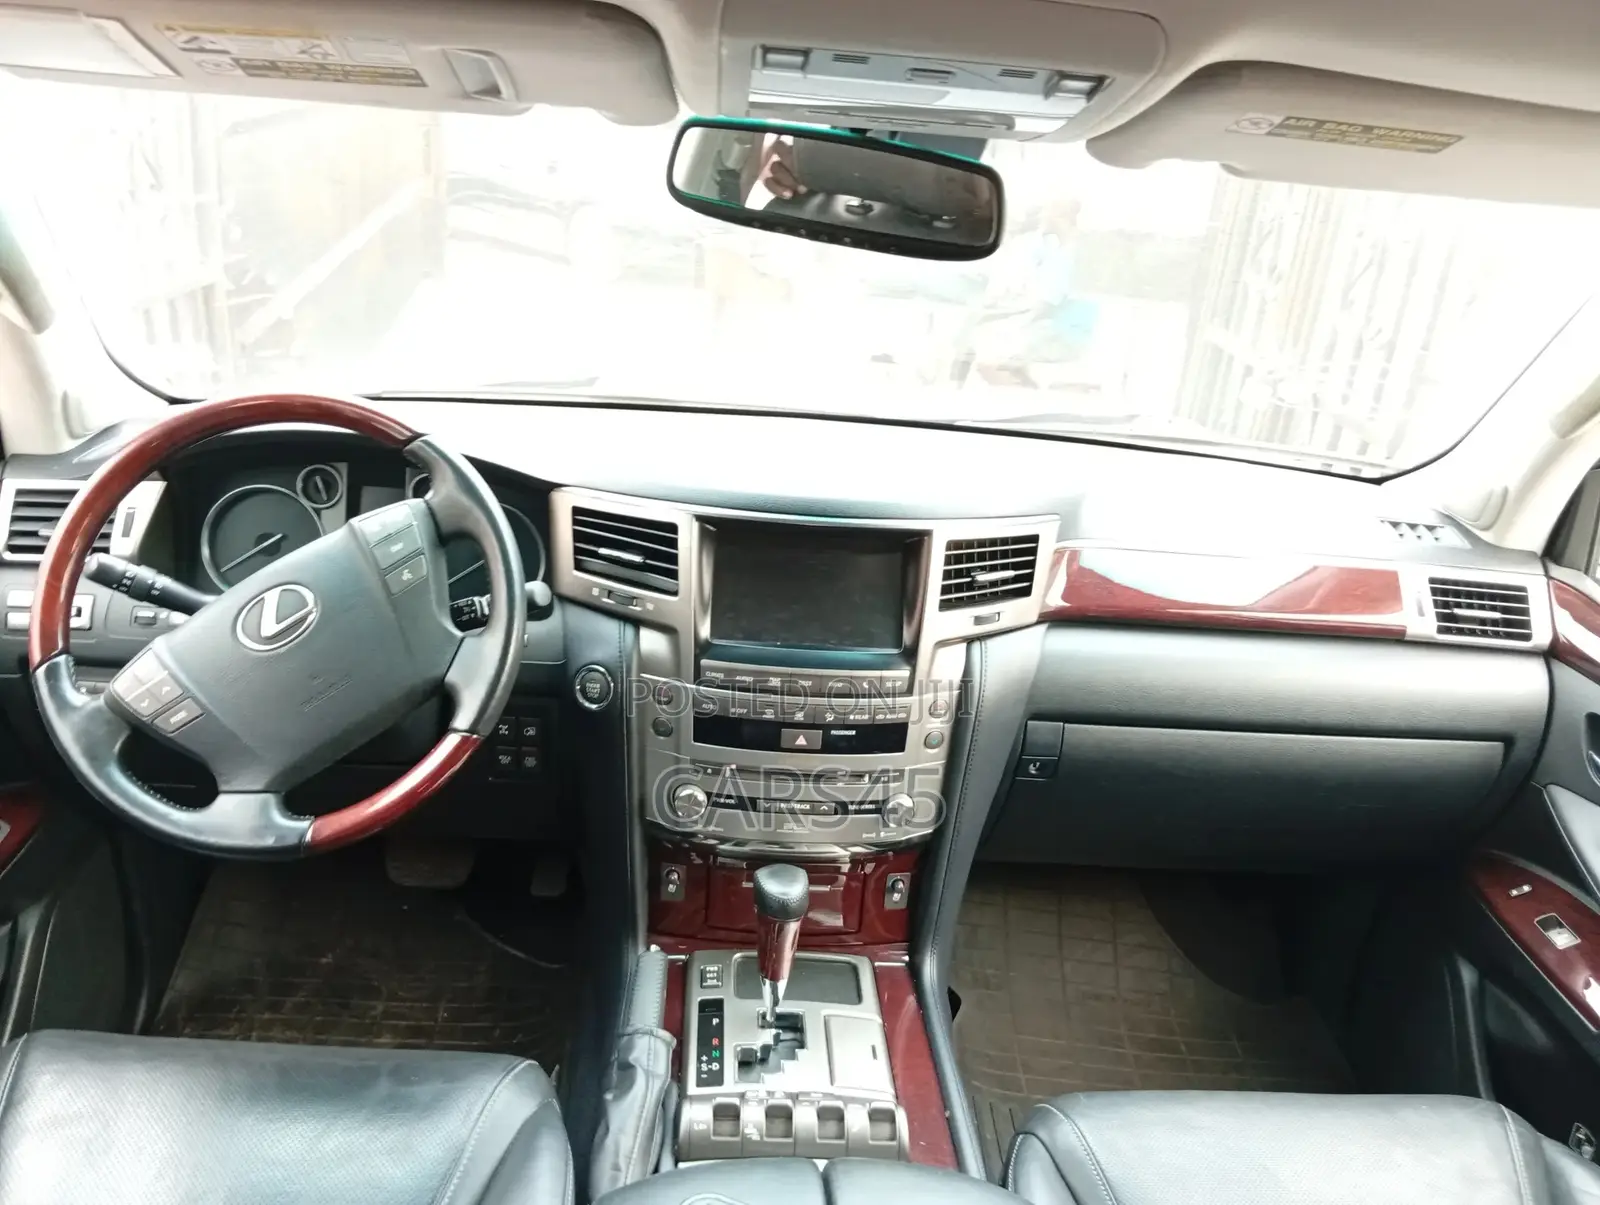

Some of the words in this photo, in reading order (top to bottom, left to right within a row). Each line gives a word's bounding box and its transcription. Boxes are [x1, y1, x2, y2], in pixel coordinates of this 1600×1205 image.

[712, 1017, 720, 1026] P
[712, 1037, 720, 1047] R
[712, 1050, 720, 1058] N
